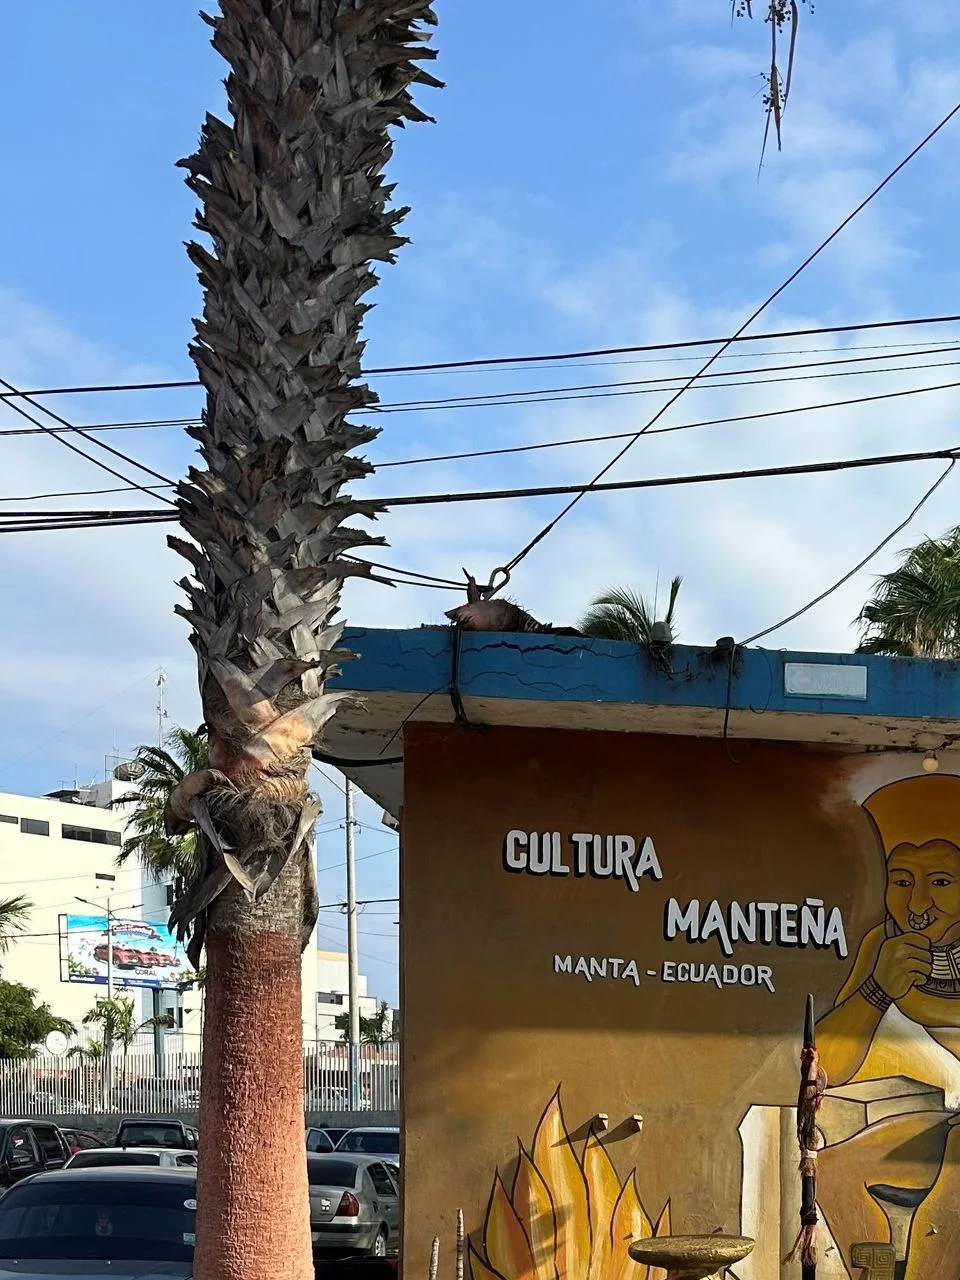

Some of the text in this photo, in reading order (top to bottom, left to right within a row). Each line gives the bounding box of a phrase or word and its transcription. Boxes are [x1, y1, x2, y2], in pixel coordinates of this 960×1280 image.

[505, 829, 664, 893] CULTURA
[665, 897, 848, 958] MANTEÑA
[134, 967, 157, 976] CORAL
[553, 954, 640, 986] MANTA
[662, 960, 775, 993] ECUADOR
